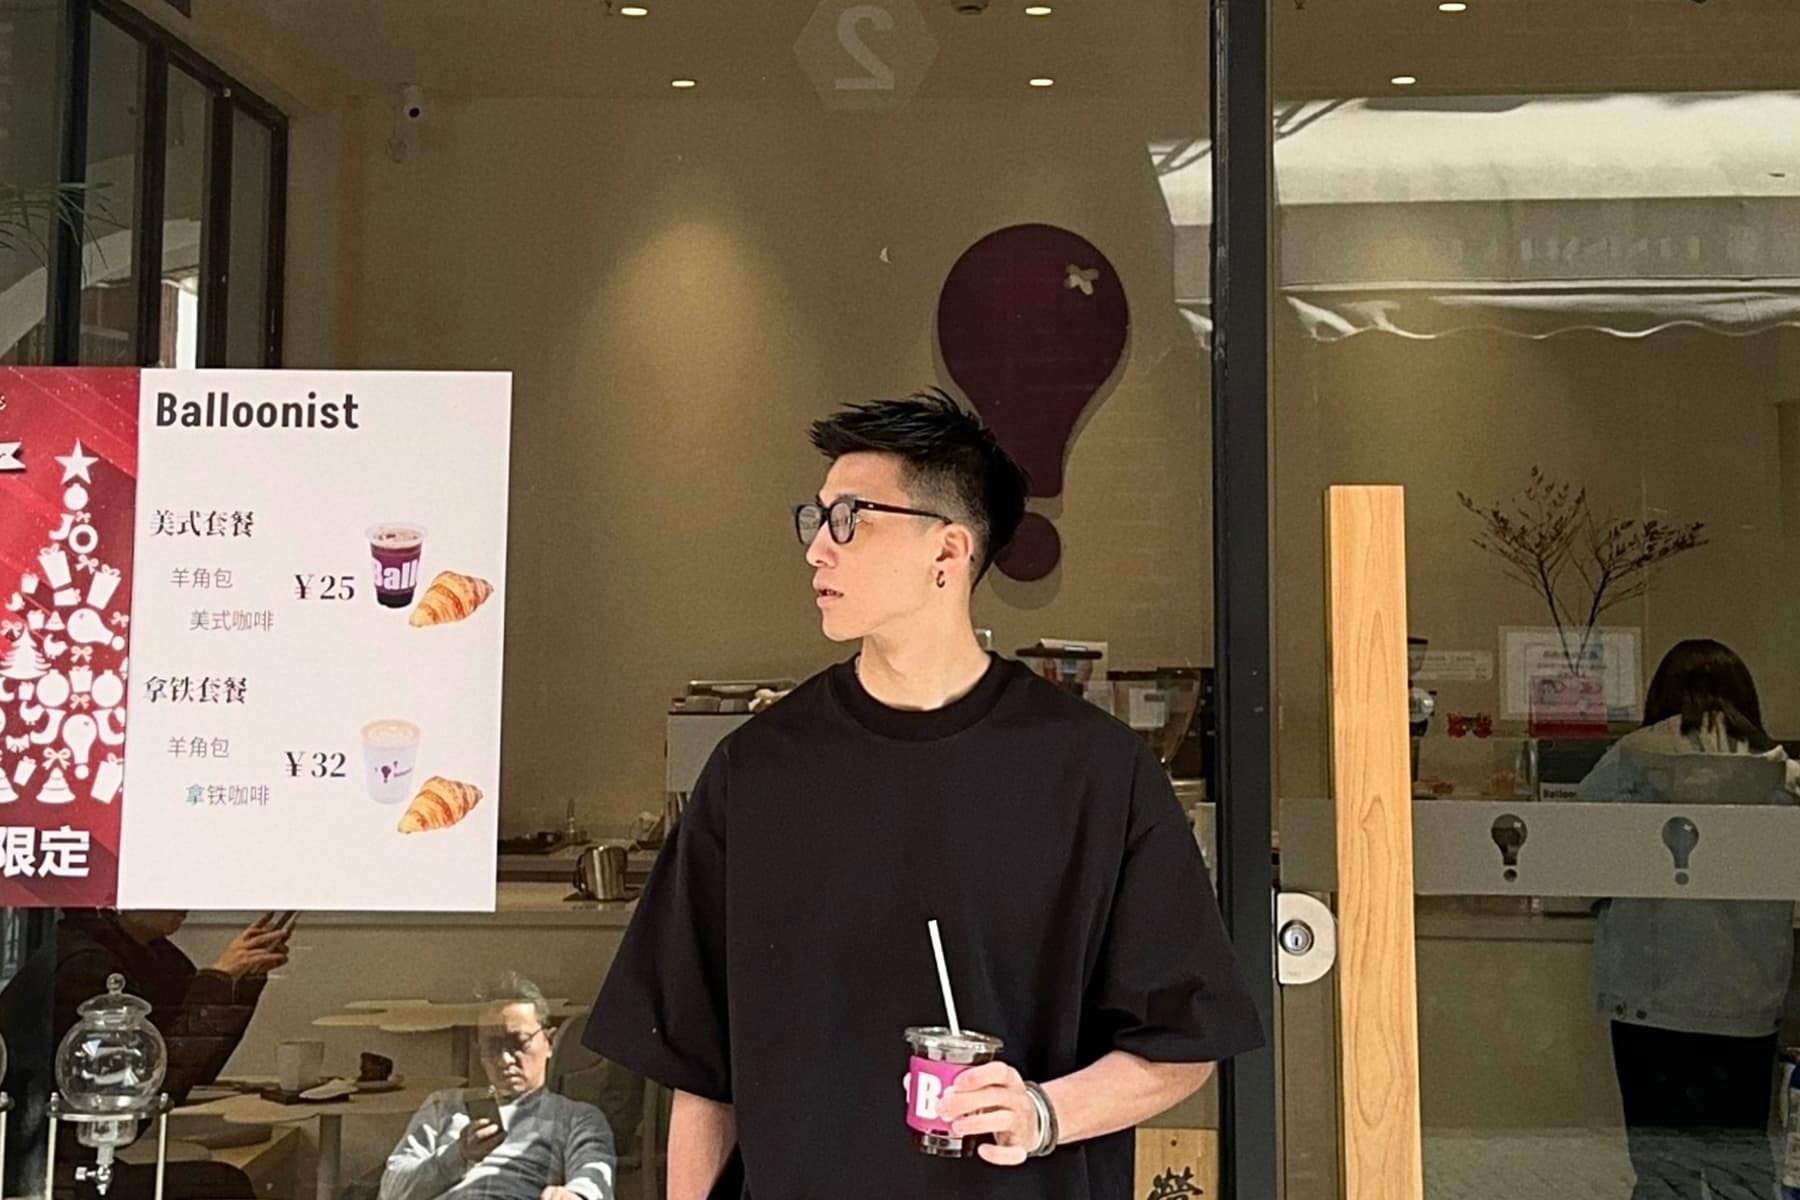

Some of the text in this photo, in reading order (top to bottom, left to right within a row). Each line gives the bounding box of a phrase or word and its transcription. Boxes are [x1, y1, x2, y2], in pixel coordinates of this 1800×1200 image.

[156, 391, 359, 429] Balloonist
[150, 509, 254, 537] 美式套餐
[170, 567, 233, 589] 羊角包
[190, 608, 274, 631] 美式咖啡
[145, 675, 247, 703] 拿铁套餐
[167, 735, 230, 758] 羊角包
[186, 783, 270, 806] 拿铁咖啡
[0, 825, 90, 878] 限定
